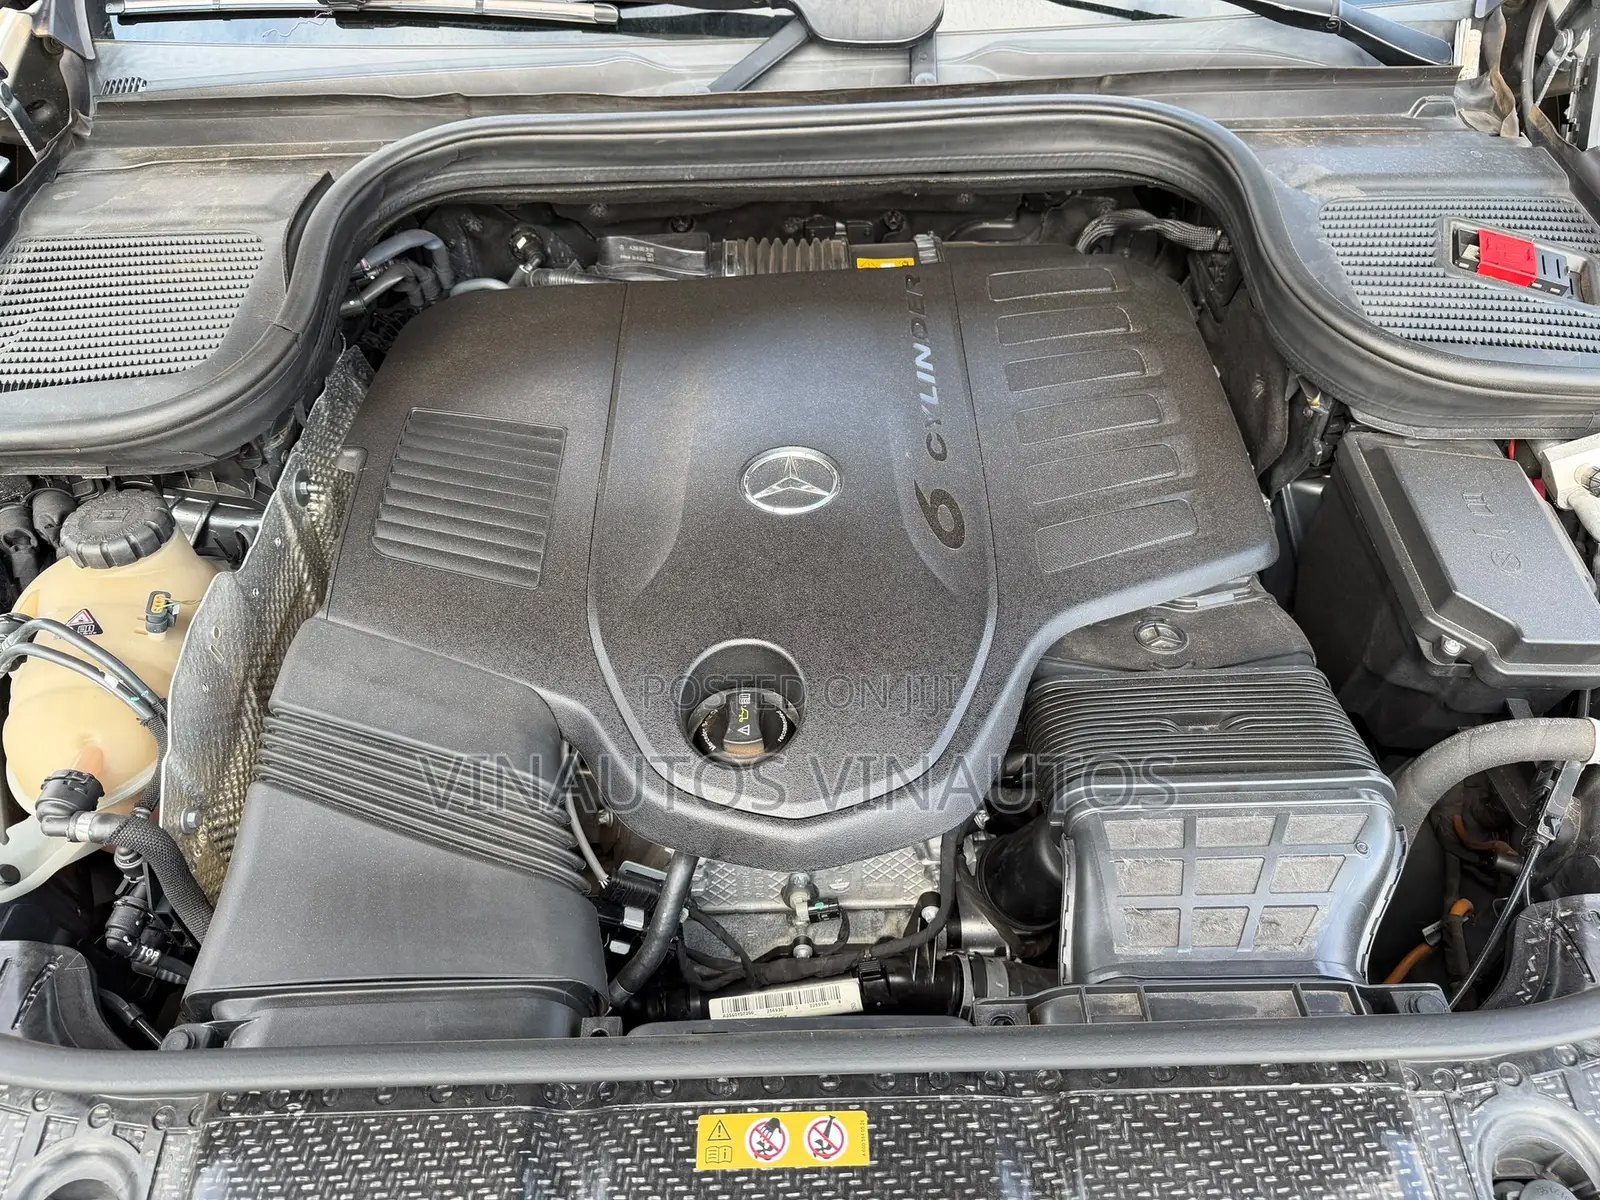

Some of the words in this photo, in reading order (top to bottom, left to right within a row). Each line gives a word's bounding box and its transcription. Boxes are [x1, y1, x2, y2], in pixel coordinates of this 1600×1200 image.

[905, 273, 948, 462] CYLINDER
[914, 478, 966, 550] 6
[140, 945, 160, 960] TOP
